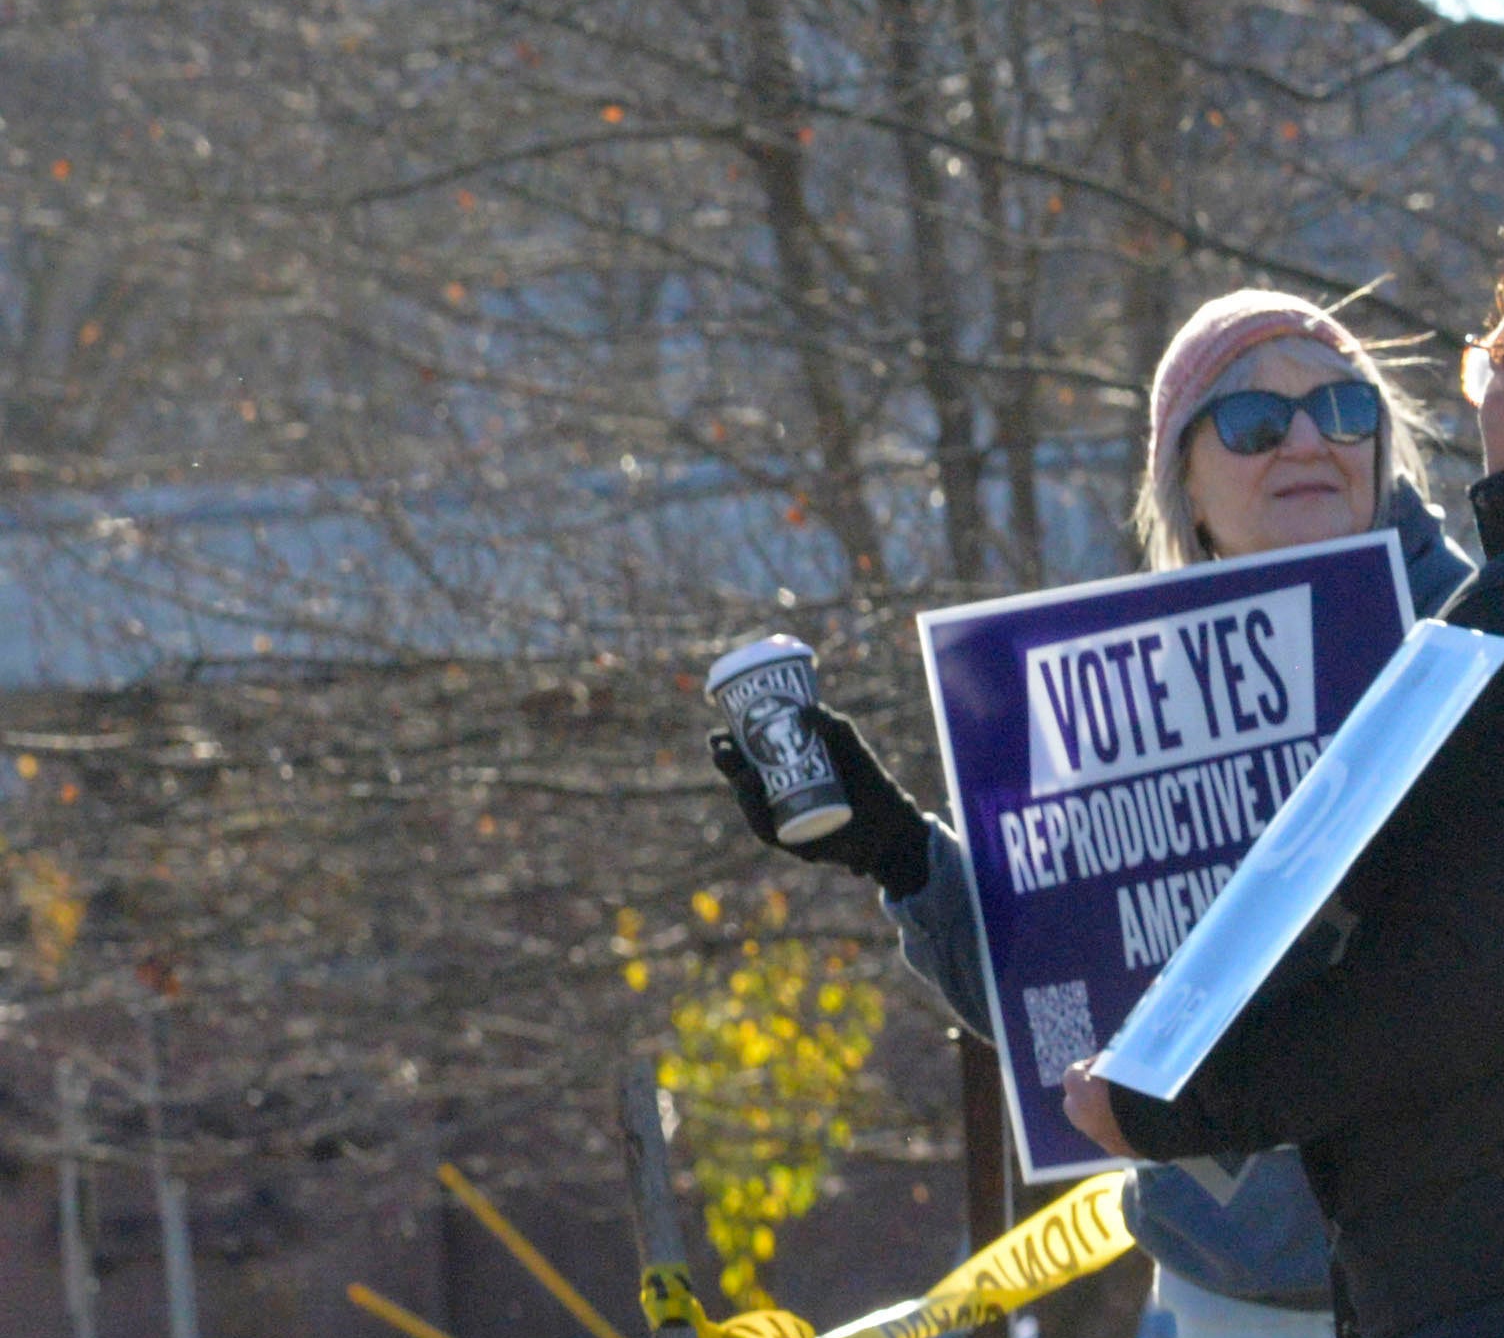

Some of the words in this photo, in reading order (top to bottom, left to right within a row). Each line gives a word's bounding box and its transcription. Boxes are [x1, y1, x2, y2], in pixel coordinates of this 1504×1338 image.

[724, 666, 803, 709] MOCHA
[1039, 633, 1181, 773] VOTE
[1179, 608, 1290, 739] YES
[1000, 755, 1266, 895] REPRODUCTIVE
[1117, 862, 1236, 971] AME
